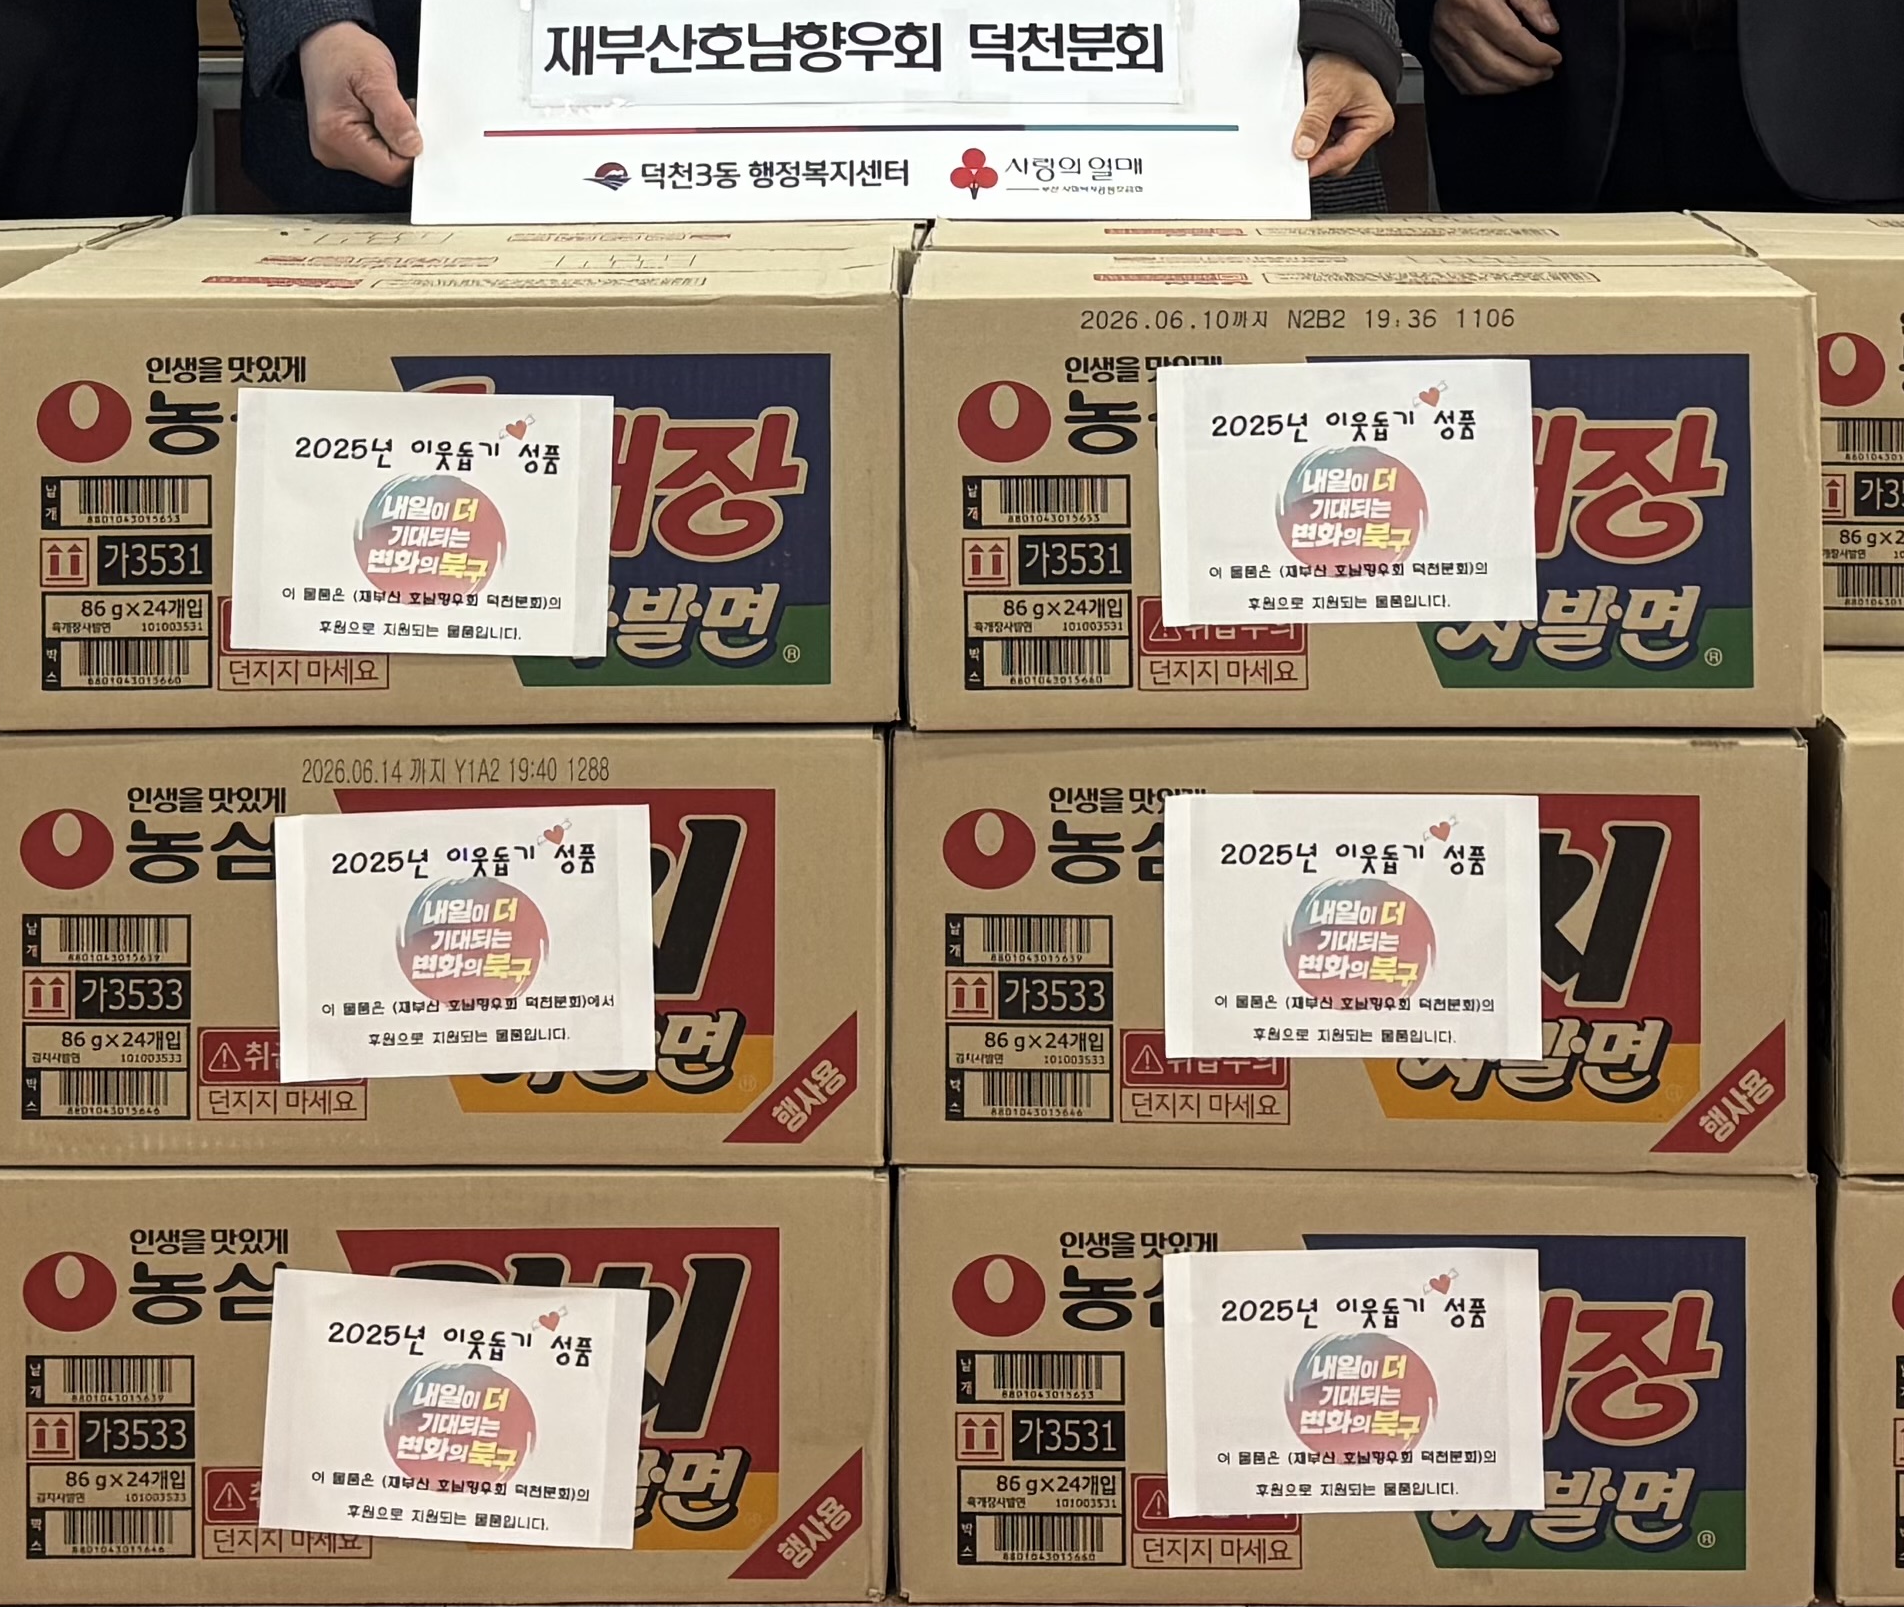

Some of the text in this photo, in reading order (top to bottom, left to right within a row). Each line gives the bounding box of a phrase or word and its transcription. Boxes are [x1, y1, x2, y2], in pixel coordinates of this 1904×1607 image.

[544, 22, 1163, 75] 재부산호남향우회 덕천분회
[642, 160, 908, 189] 덕천3동 행정복지센터
[1288, 310, 1345, 328] N2B2
[1366, 309, 1436, 328] 19:36
[1458, 309, 1514, 328] 1106
[296, 437, 560, 474] 2025년 이웃돕기 성품
[105, 543, 202, 578] 가3531
[1026, 542, 1122, 578] 가3531
[81, 601, 105, 617] 86
[302, 759, 402, 783] 2026.06.14
[455, 758, 499, 783] Y1A2
[510, 757, 556, 782] 19:40
[569, 757, 609, 781] 1288
[82, 978, 182, 1012] 가3533
[1005, 978, 1104, 1013] 가3533
[209, 1089, 357, 1115] 던지지 마세요
[772, 1057, 847, 1132] 행사용
[1222, 1298, 1486, 1328] 2025년 이웃돕기 성품
[86, 1418, 186, 1452] 가3533
[1019, 1418, 1116, 1454] 가3531
